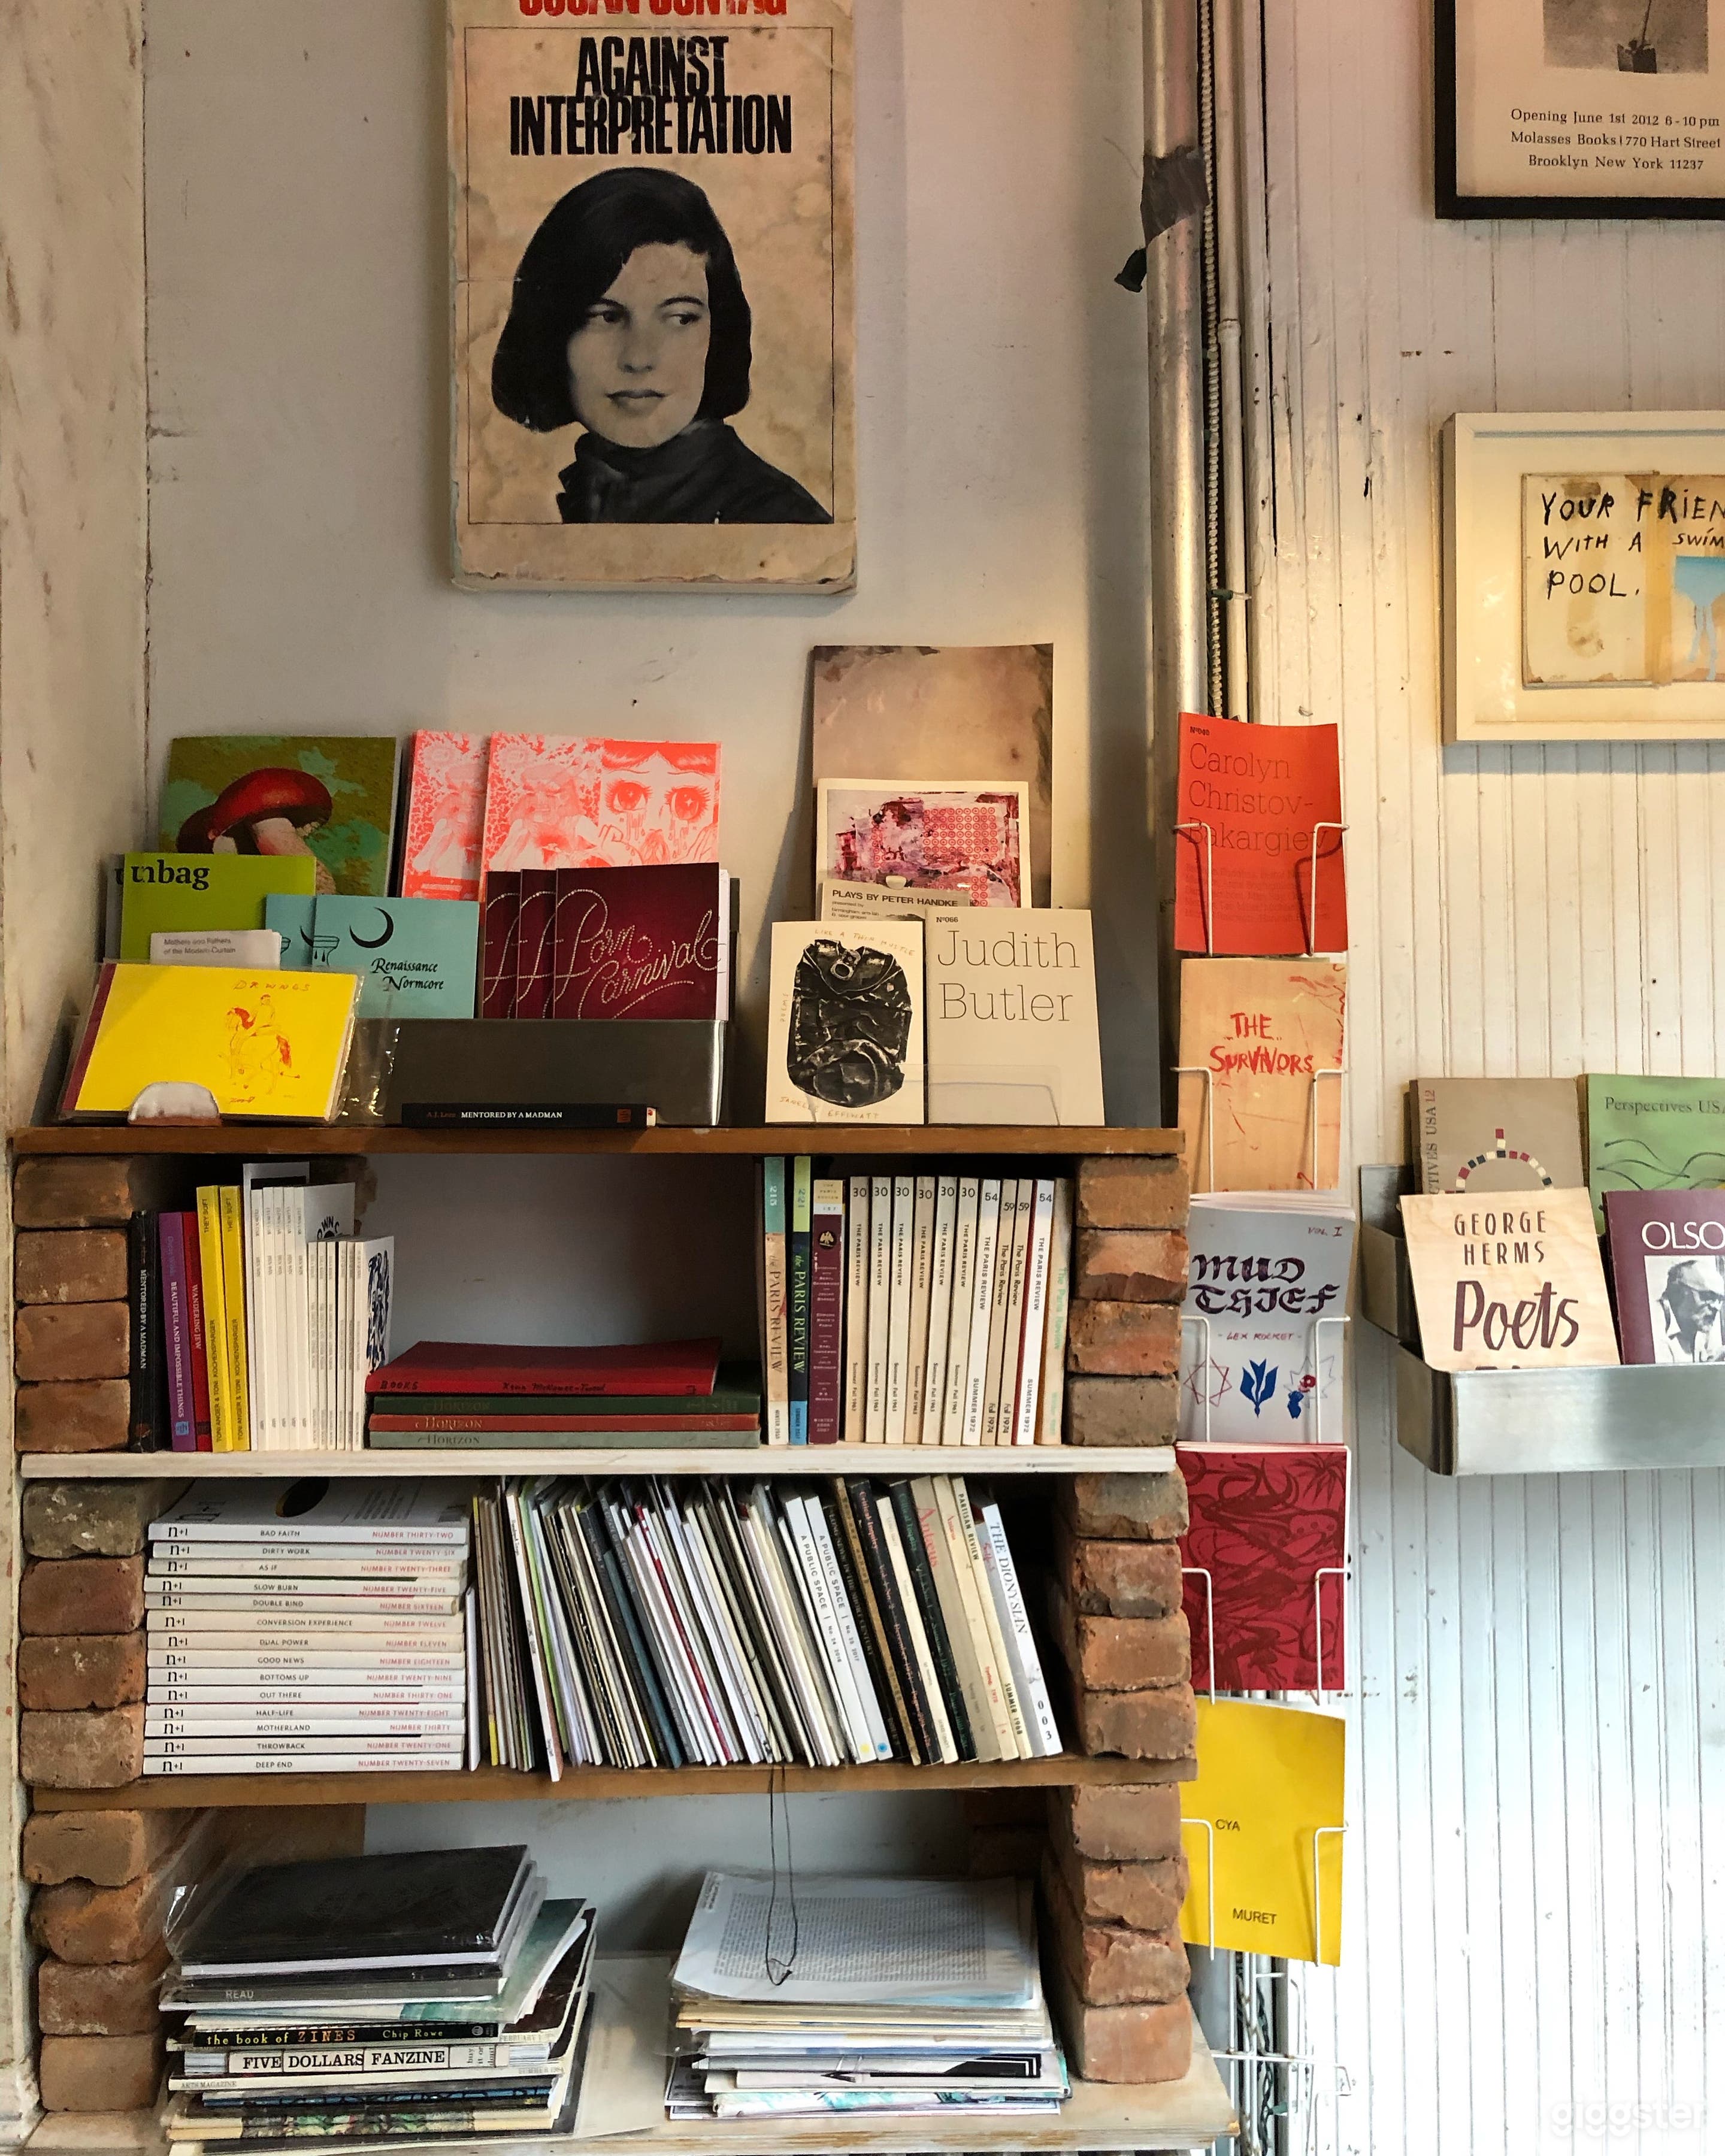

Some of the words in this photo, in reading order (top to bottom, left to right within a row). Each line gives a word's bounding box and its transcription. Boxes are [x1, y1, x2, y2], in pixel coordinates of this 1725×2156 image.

[576, 36, 729, 98] AGAINST
[510, 95, 792, 156] INTERPRETATION
[1511, 108, 1567, 124] Opening
[1573, 111, 1603, 124] June
[1609, 113, 1626, 124] 1st
[1632, 114, 1659, 126] 2012
[1700, 117, 1720, 128] pm
[1511, 131, 1571, 145] Molasses
[1578, 133, 1616, 146] Books
[1626, 136, 1647, 147] 770
[1651, 136, 1680, 148] Hart
[1684, 137, 1721, 149] Street
[1529, 155, 1588, 169] Brooklyn
[1595, 156, 1626, 167] New
[1633, 157, 1663, 169] York
[1670, 159, 1704, 169] 11237
[1542, 491, 1614, 525] YOUR
[1543, 533, 1608, 560] WITH
[1629, 531, 1642, 553] A
[1548, 570, 1641, 600] POOL.
[1190, 743, 1291, 783] Carolyn
[1189, 780, 1314, 816] Christov-
[1188, 817, 1329, 857] Bakargiev
[131, 858, 211, 891] unbag
[833, 889, 863, 900] PLAYS
[882, 895, 914, 905] PETER
[917, 898, 958, 907] HANDKE
[556, 888, 654, 1001] Porn
[938, 930, 1081, 970] Judith
[371, 956, 438, 974] Renaissance
[577, 909, 721, 1020] Carnival
[383, 976, 445, 992] Normcore
[939, 982, 1076, 1023] Butler
[1230, 1012, 1275, 1040] THE
[1208, 1044, 1315, 1076] SURVIVORS
[1425, 1089, 1436, 1103] 12
[1605, 1097, 1693, 1116] Perspectives
[1699, 1100, 1725, 1115] US
[1426, 1106, 1438, 1135] USA
[853, 1188, 867, 1197] 30
[874, 1186, 888, 1197] 30
[896, 1187, 910, 1197] 30
[961, 1187, 976, 1198] 30
[984, 1192, 998, 1202] 54
[1039, 1193, 1052, 1203] 54
[1003, 1202, 1015, 1212] 59
[1454, 1210, 1547, 1236] GEORGE
[1001, 1244, 1009, 1258] The
[1464, 1241, 1545, 1266] HERMS
[981, 1253, 989, 1277] PARIS
[999, 1259, 1008, 1277] Paris
[1191, 1253, 1306, 1284] MUD
[171, 1281, 180, 1324] BEAUTIFUL
[770, 1271, 782, 1313] PARIS
[794, 1271, 806, 1313] PARIS
[979, 1279, 989, 1310] REVIEW
[997, 1279, 1006, 1306] Review
[1189, 1283, 1340, 1319] THIEF
[140, 1314, 147, 1324] BY
[192, 1283, 200, 1334] WANDERING
[1453, 1280, 1579, 1352] Poets
[172, 1325, 181, 1343] AND
[193, 1334, 202, 1349] JEW
[770, 1318, 782, 1373] REVIEW
[793, 1318, 806, 1374] REVIEW
[140, 1332, 148, 1369] MADMAN
[174, 1343, 183, 1387] IMPOSSIBLE
[380, 1380, 418, 1391] BOOKS
[970, 1377, 979, 1413] SUMMER
[176, 1387, 185, 1418] THINGS
[419, 1432, 480, 1445] HORIZON
[168, 1527, 189, 1539] n+1
[372, 1531, 404, 1539] NUMBER
[958, 1493, 972, 1530] PARTISAN
[968, 1533, 980, 1561] REVIEW
[990, 1522, 1007, 1554] THE
[804, 1543, 818, 1577] PUBLIC
[813, 1579, 828, 1609] SPACE
[998, 1557, 1028, 1634] DIONYSIAN
[165, 1617, 185, 1628] n+1
[257, 1618, 306, 1627] CONVERSION
[308, 1619, 353, 1627] EXPERIENCE
[383, 1619, 416, 1628] NUMBER
[418, 1620, 447, 1628] TWELVE
[165, 1655, 186, 1666] n+1
[258, 1656, 282, 1664] GOOD
[379, 1657, 411, 1666] NUMBER
[413, 1658, 450, 1666] EIGHTEEN
[1004, 1682, 1018, 1713] SUMMER
[163, 1723, 184, 1734] n+1
[256, 1723, 311, 1732] MOTHERLAND
[389, 1723, 422, 1731] NUMBER
[423, 1724, 451, 1732] THIRTY
[162, 1760, 183, 1772] n+1
[255, 1760, 276, 1769] DEEP
[358, 1759, 391, 1768] NUMBER
[392, 1758, 450, 1768] TWENTY-SEVEN
[1215, 1818, 1240, 1831] CYA
[1233, 1908, 1278, 1925] MURET
[207, 2034, 229, 2046] the
[236, 2033, 268, 2045] book
[276, 2033, 289, 2043] of
[298, 2030, 356, 2042] ZINES
[383, 2030, 408, 2039] Chip
[414, 2029, 444, 2037] Rowe
[243, 2056, 282, 2070] FIVE
[288, 2054, 364, 2068] DOLLARS
[371, 2051, 446, 2066] FANZINE
